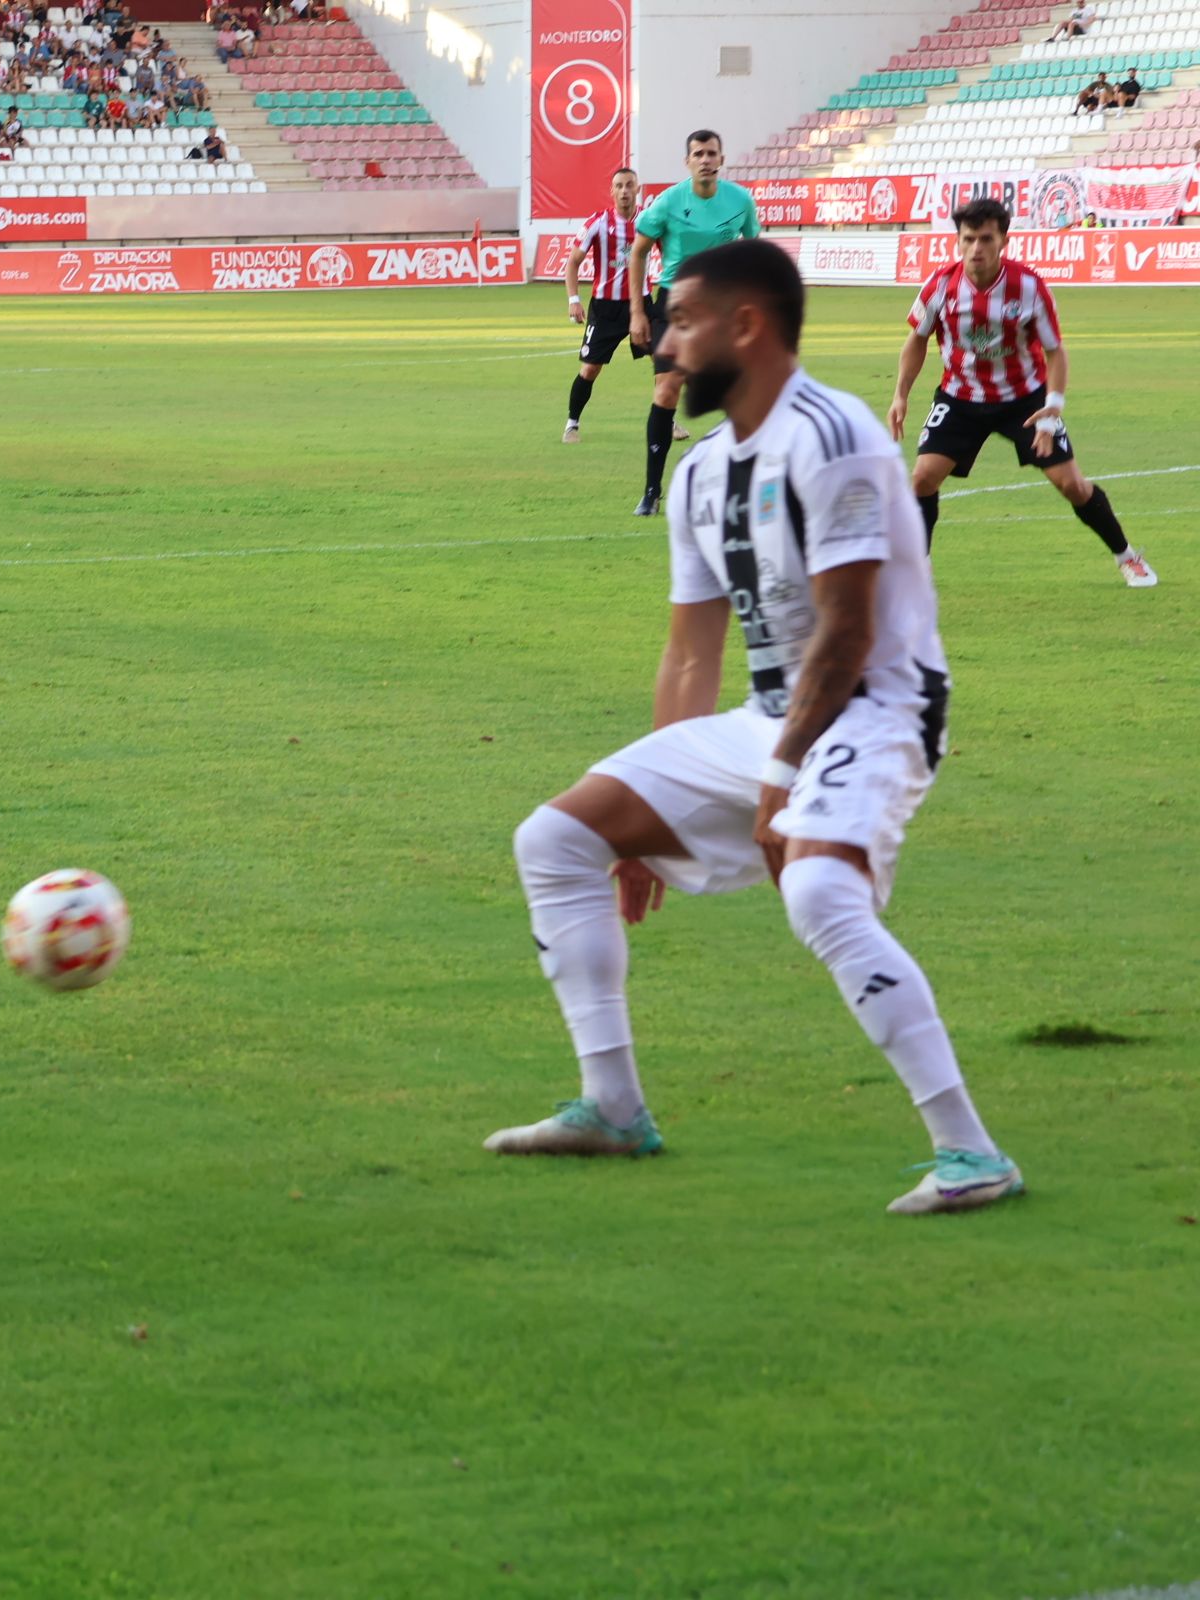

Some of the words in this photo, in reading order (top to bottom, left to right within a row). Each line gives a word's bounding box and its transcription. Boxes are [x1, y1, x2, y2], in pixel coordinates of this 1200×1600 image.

[539, 29, 622, 44] MONTETORO
[565, 79, 595, 125] 8
[750, 182, 810, 200] .cubiex.es
[815, 179, 867, 200] FUNDACIÓN
[211, 247, 301, 268] FUNDACIÓN
[1009, 235, 1024, 261] DE
[1027, 236, 1043, 261] LA
[1045, 235, 1086, 261] PLATA
[480, 246, 517, 277] CF
[88, 272, 179, 292] ZAMORA
